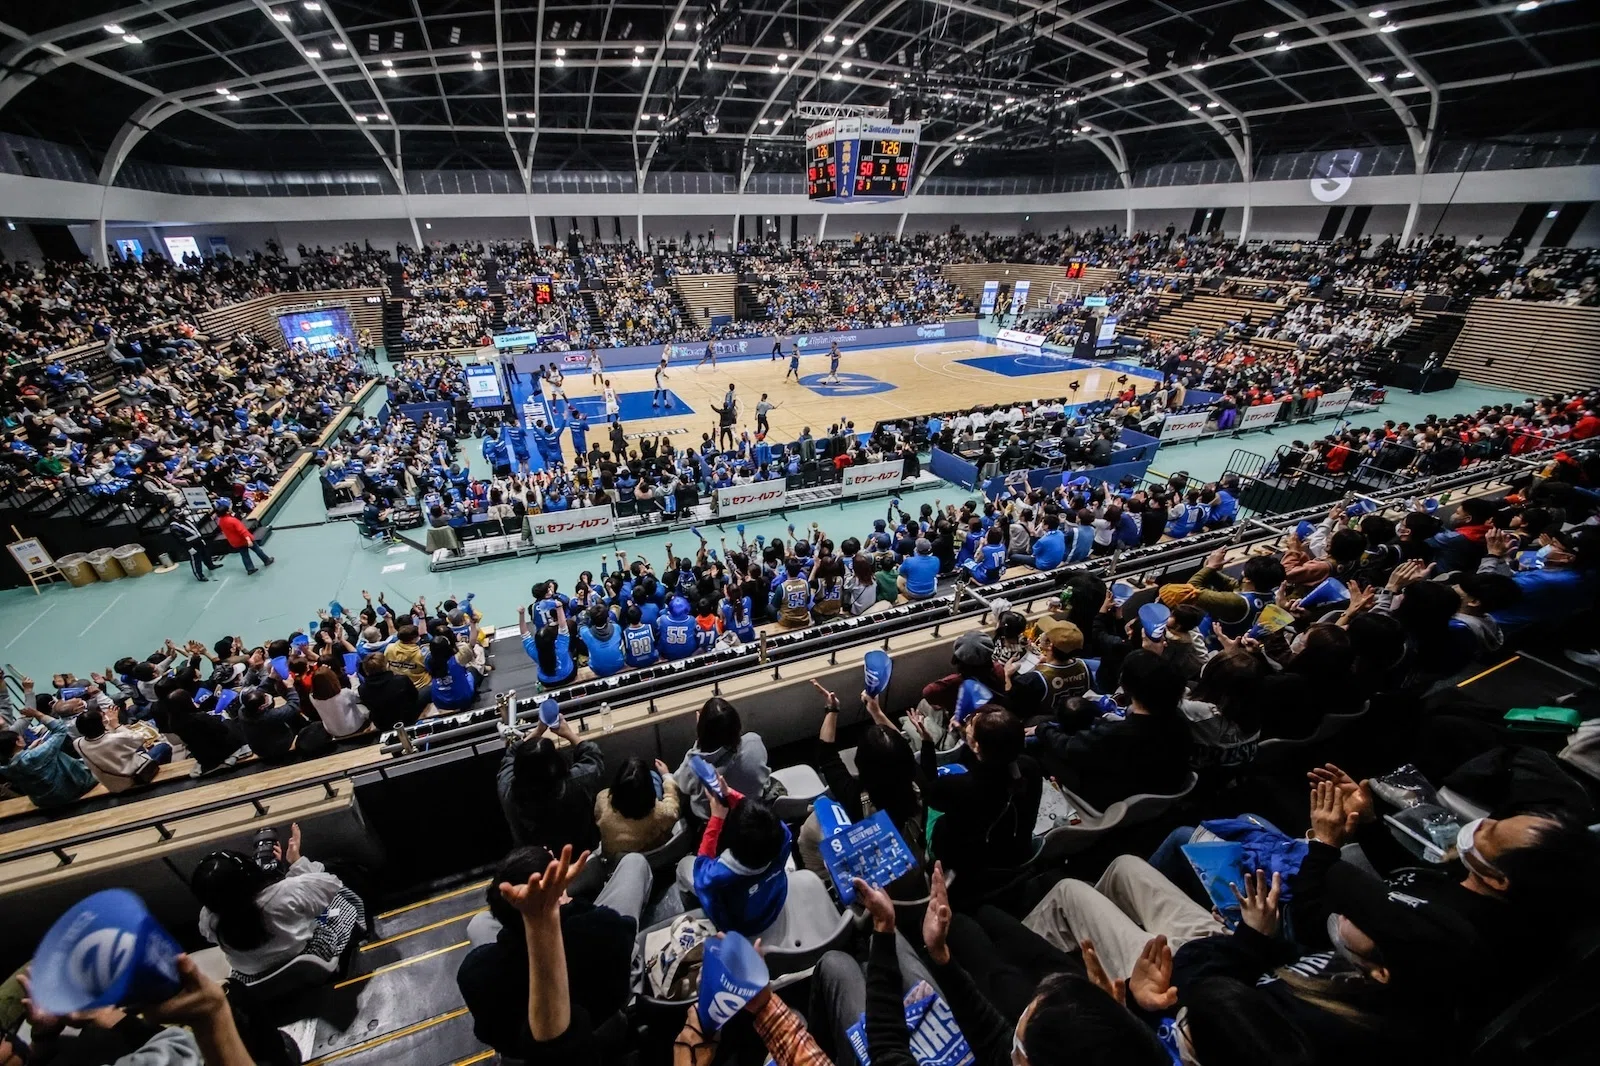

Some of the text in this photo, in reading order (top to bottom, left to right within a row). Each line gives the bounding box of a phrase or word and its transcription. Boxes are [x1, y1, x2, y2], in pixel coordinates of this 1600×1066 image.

[881, 141, 899, 155] 7:26
[861, 162, 873, 176] 50
[881, 164, 887, 175] 3
[897, 164, 908, 177] 43
[858, 180, 864, 190] 2
[536, 291, 550, 303] 24
[547, 517, 609, 533] セブン-イレブン
[992, 551, 1006, 568] 17
[788, 591, 806, 608] 55
[667, 626, 688, 644] 55
[696, 630, 715, 645] 77
[630, 636, 651, 656] 88
[1063, 672, 1086, 682] MYNET
